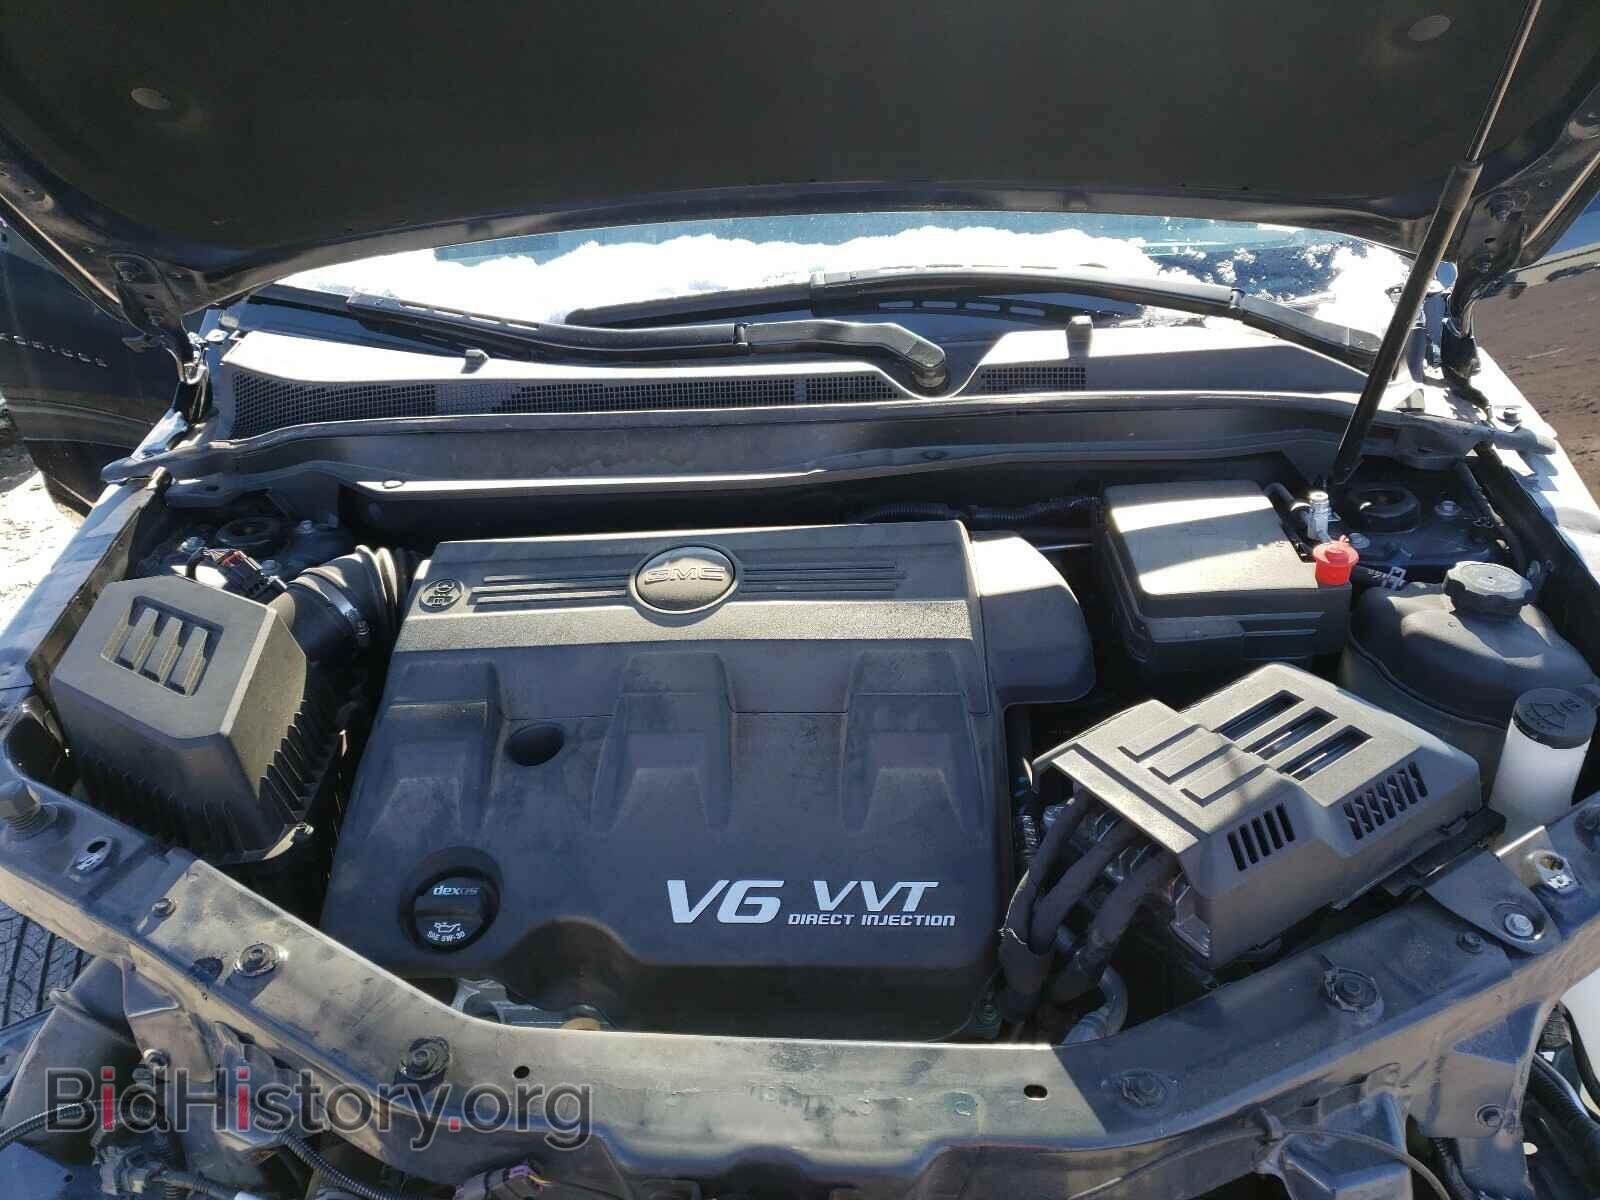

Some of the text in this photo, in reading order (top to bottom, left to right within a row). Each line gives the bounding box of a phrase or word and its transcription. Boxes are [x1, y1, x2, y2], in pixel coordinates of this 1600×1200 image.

[646, 567, 726, 584] GMC
[433, 885, 478, 896] dexos
[667, 879, 939, 924] V6 VVT
[787, 914, 956, 927] DIRECT INJECTION
